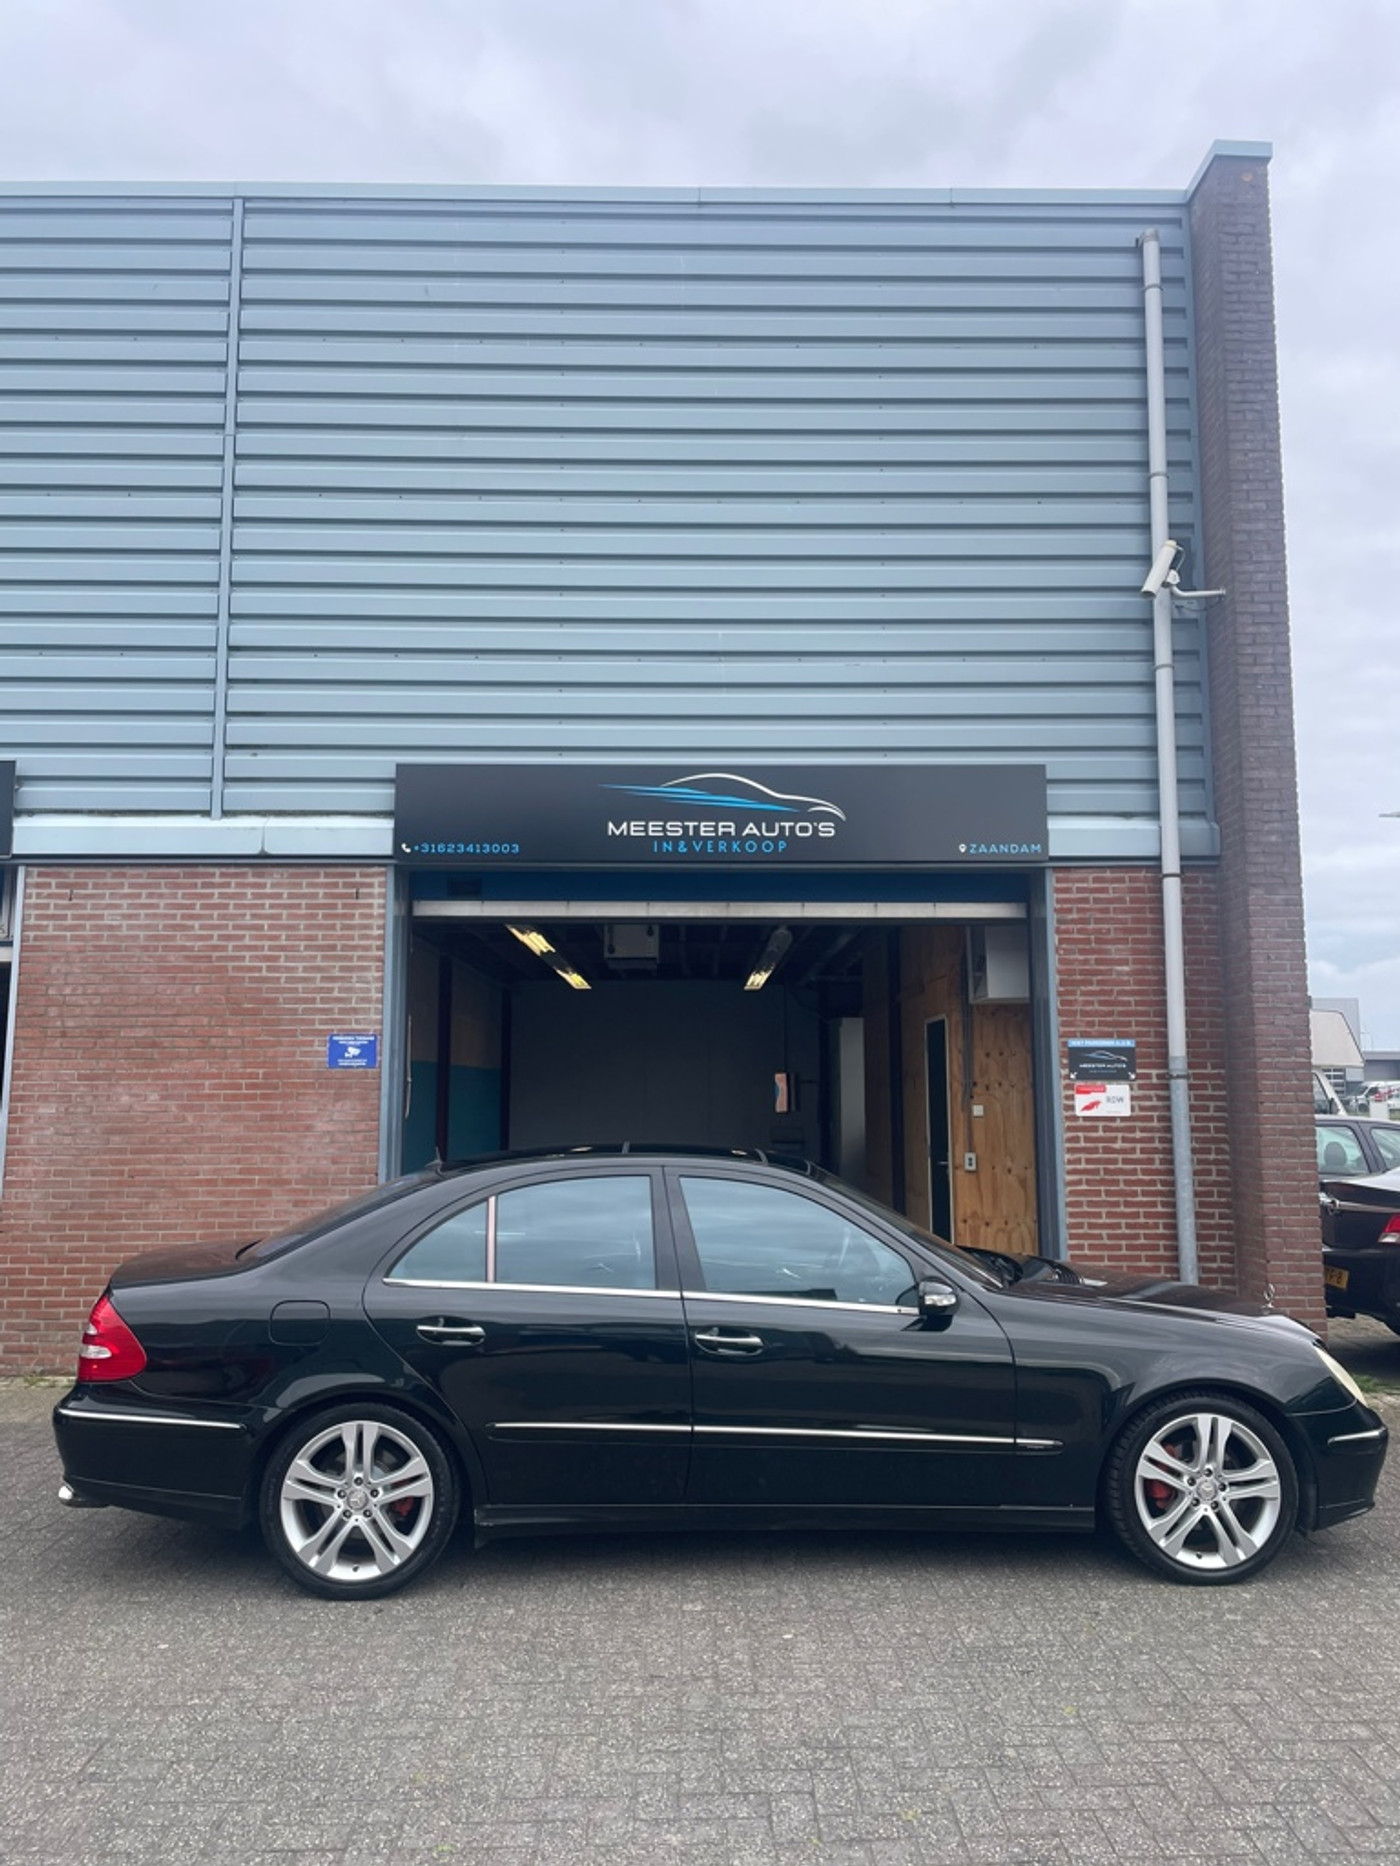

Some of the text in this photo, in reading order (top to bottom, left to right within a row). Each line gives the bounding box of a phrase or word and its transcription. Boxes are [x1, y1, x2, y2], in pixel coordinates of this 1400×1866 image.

[608, 821, 836, 837] MEESTER AUTO'S
[413, 842, 520, 854] +31623413003
[969, 843, 1042, 854] ZAANDAM
